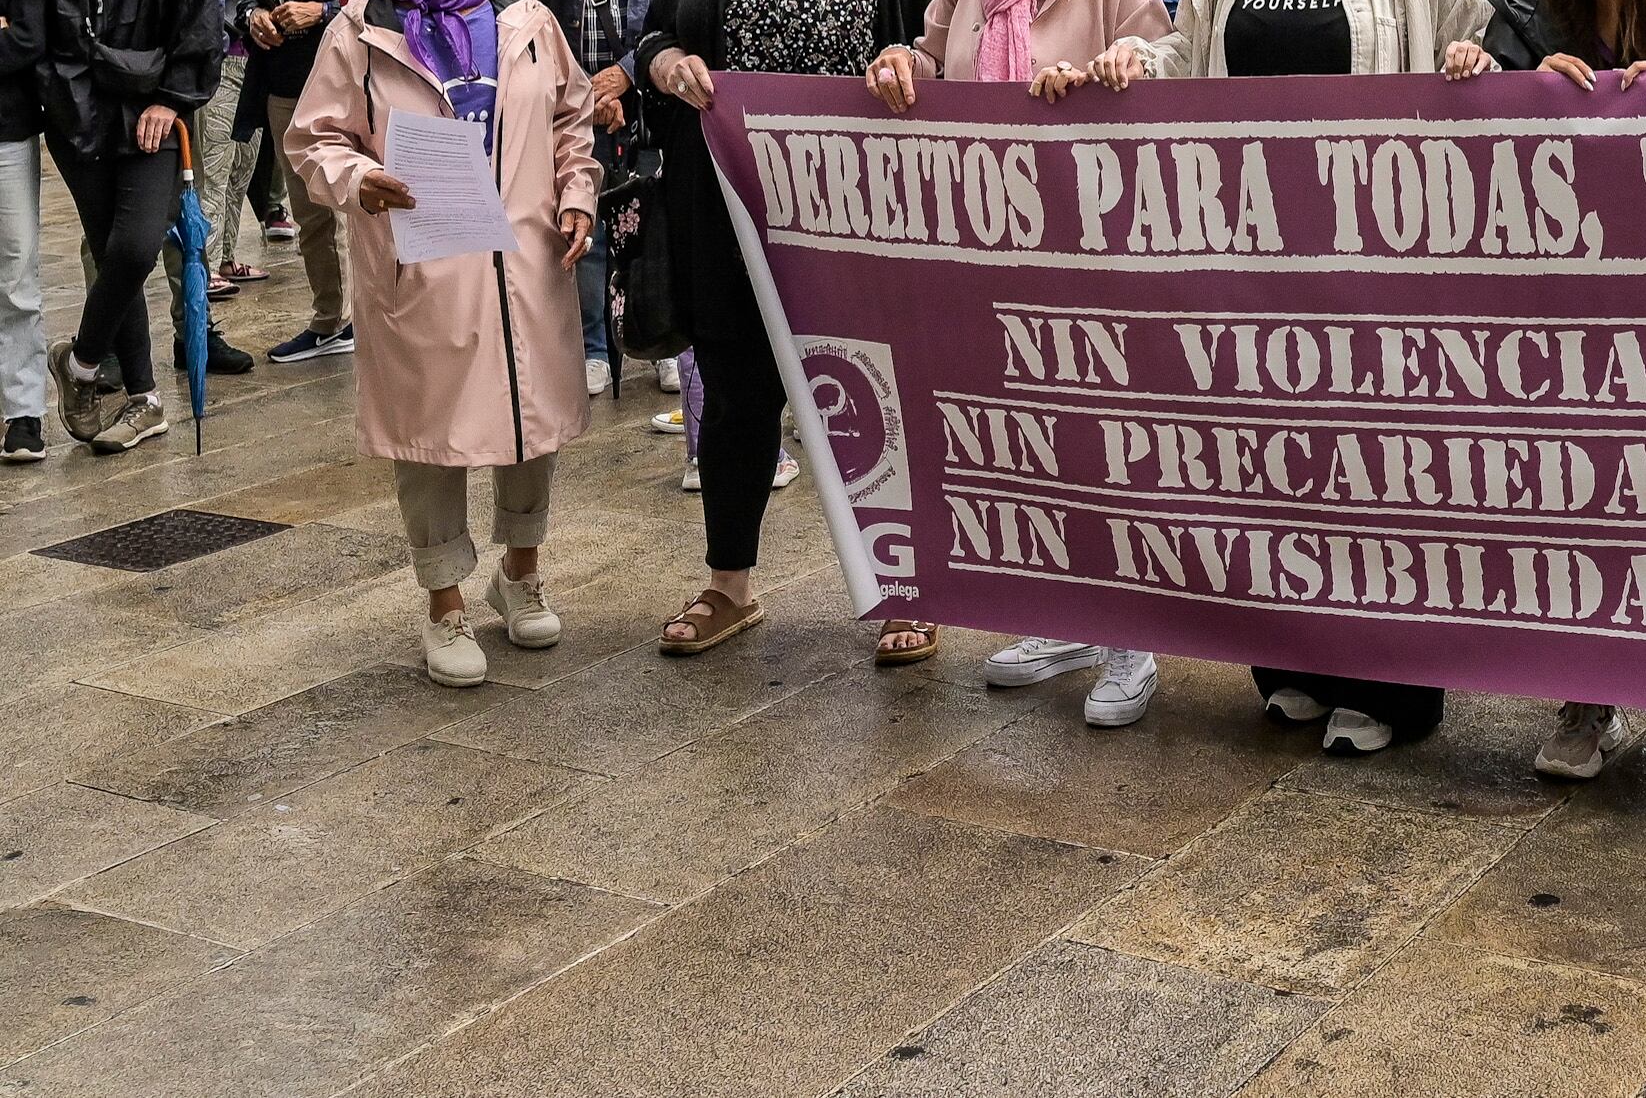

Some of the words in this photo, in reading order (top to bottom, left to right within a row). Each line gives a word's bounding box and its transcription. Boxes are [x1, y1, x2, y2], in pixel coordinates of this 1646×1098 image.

[748, 131, 1045, 250] DEREITOS
[1071, 140, 1285, 253] PARA
[1315, 137, 1604, 260] TODAS,
[996, 313, 1130, 387] NIN
[936, 402, 1059, 478] NIN
[944, 494, 1071, 571] NIN
[879, 580, 921, 603] galega
